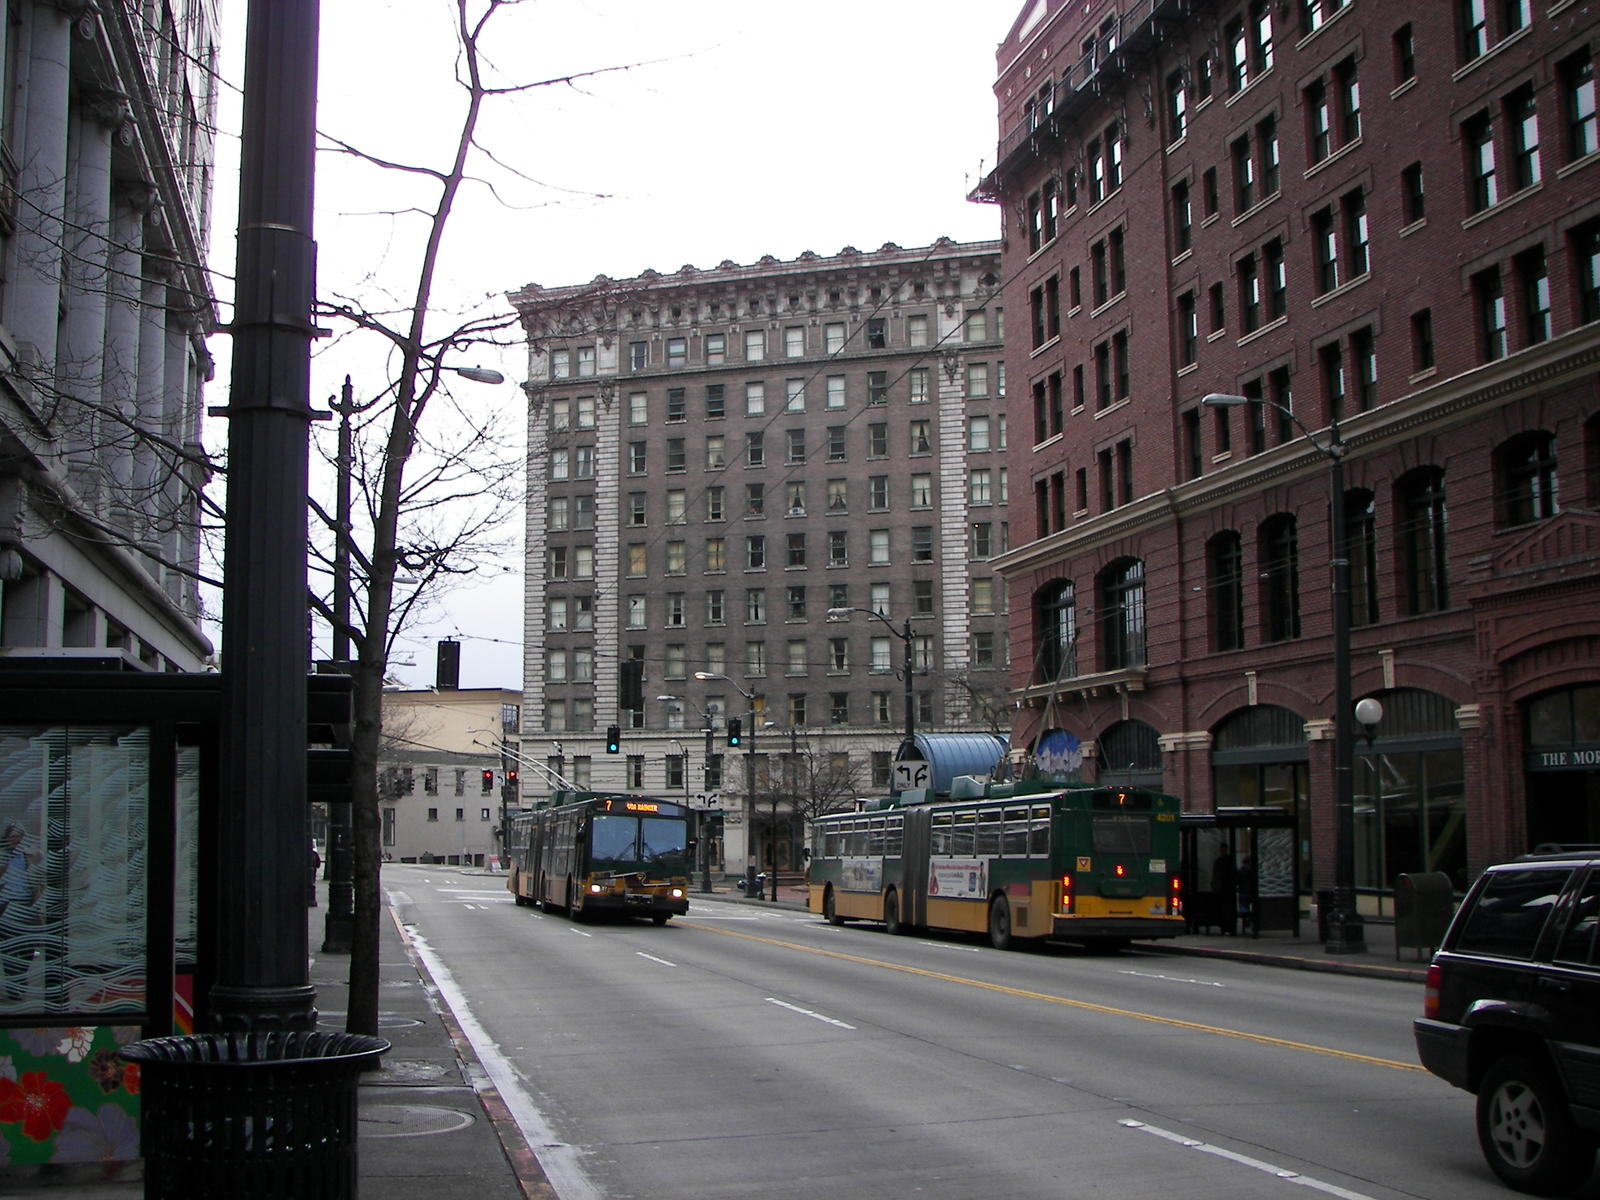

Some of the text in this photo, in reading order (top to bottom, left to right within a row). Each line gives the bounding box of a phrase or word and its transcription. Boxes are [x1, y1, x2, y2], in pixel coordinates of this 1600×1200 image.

[1541, 751, 1568, 766] THE
[1118, 793, 1125, 805] 7
[605, 800, 612, 811] 7
